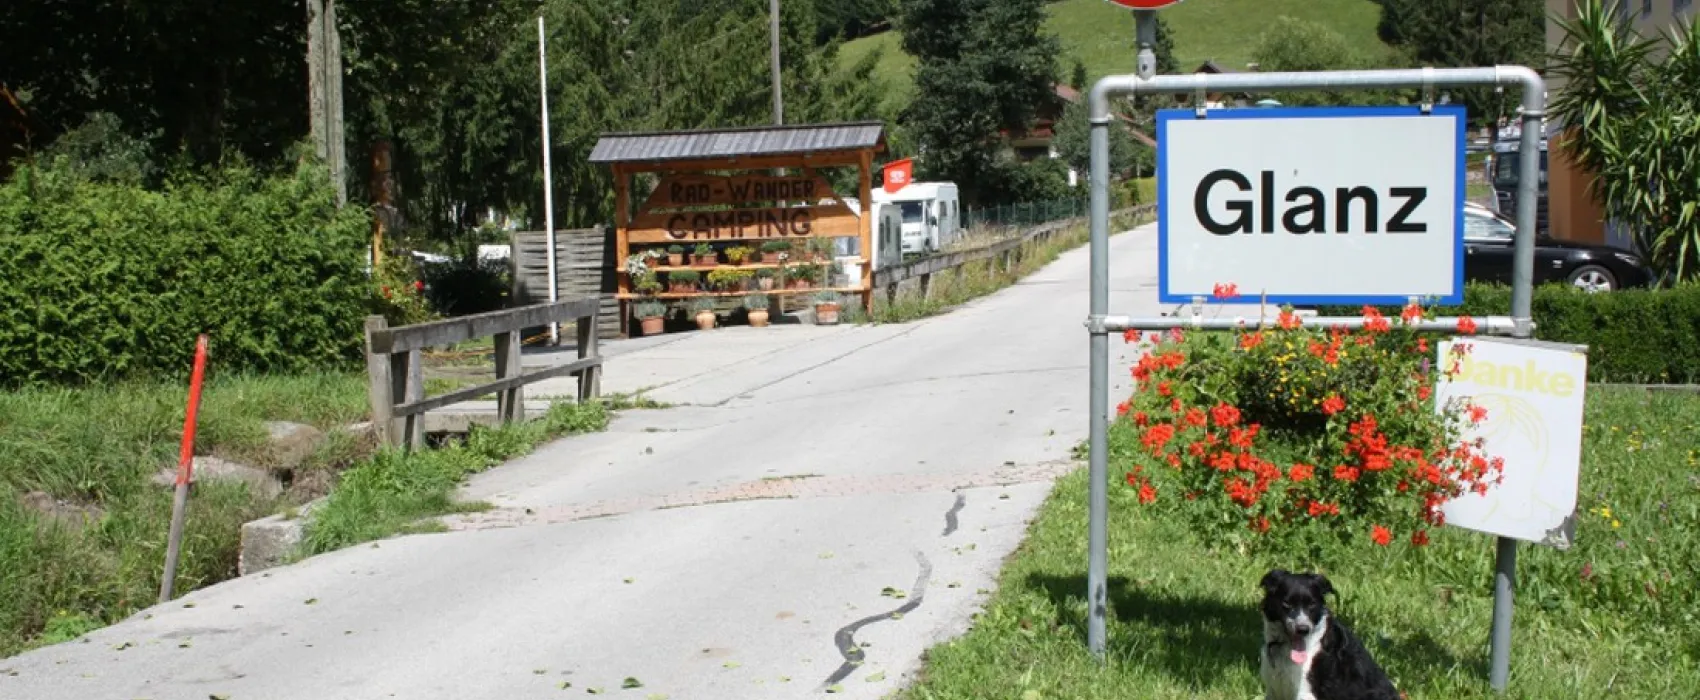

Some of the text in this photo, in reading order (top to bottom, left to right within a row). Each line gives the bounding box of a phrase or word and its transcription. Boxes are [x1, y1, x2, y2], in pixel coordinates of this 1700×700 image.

[667, 208, 812, 239] CAMPING
[1194, 168, 1427, 236] Glanz
[1444, 350, 1576, 397] Danke
